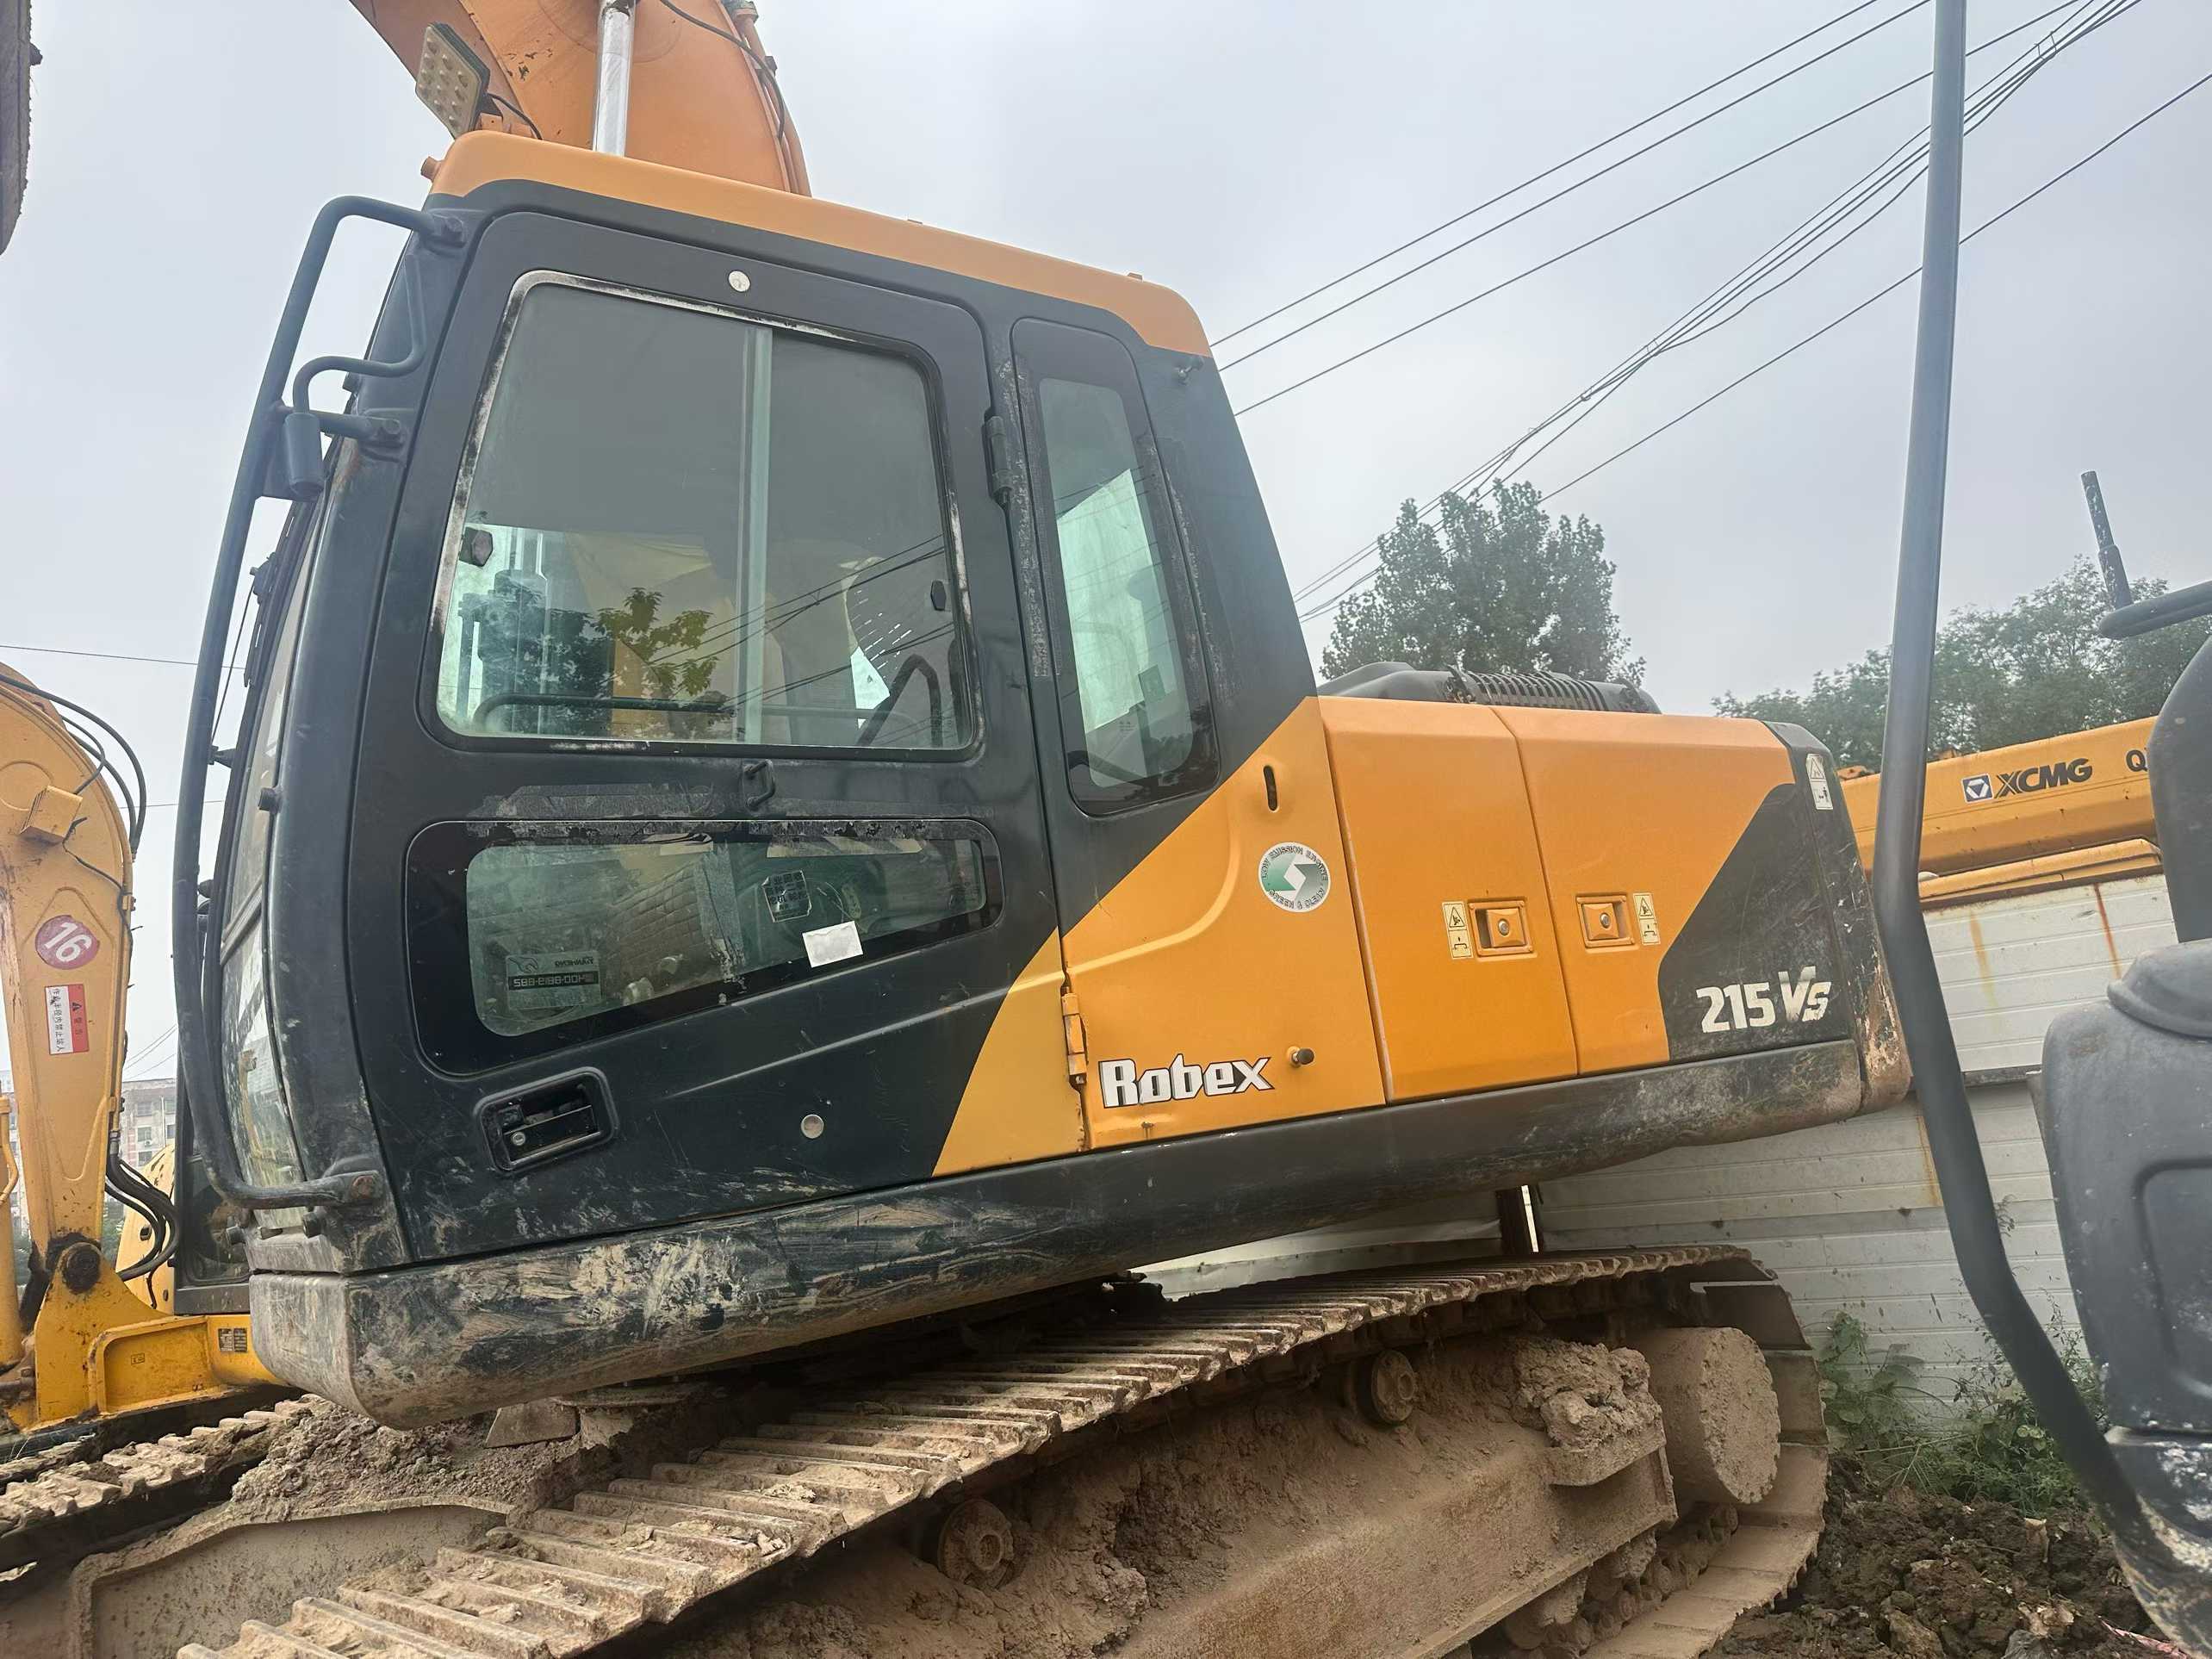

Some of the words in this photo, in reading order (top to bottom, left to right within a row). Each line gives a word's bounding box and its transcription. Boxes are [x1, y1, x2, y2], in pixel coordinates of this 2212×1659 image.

[1994, 758, 2092, 798] XCMG
[2126, 747, 2148, 773] Q
[44, 922, 92, 963] 16
[1696, 982, 1776, 1033] 215
[1098, 1053, 1276, 1109] Robex
